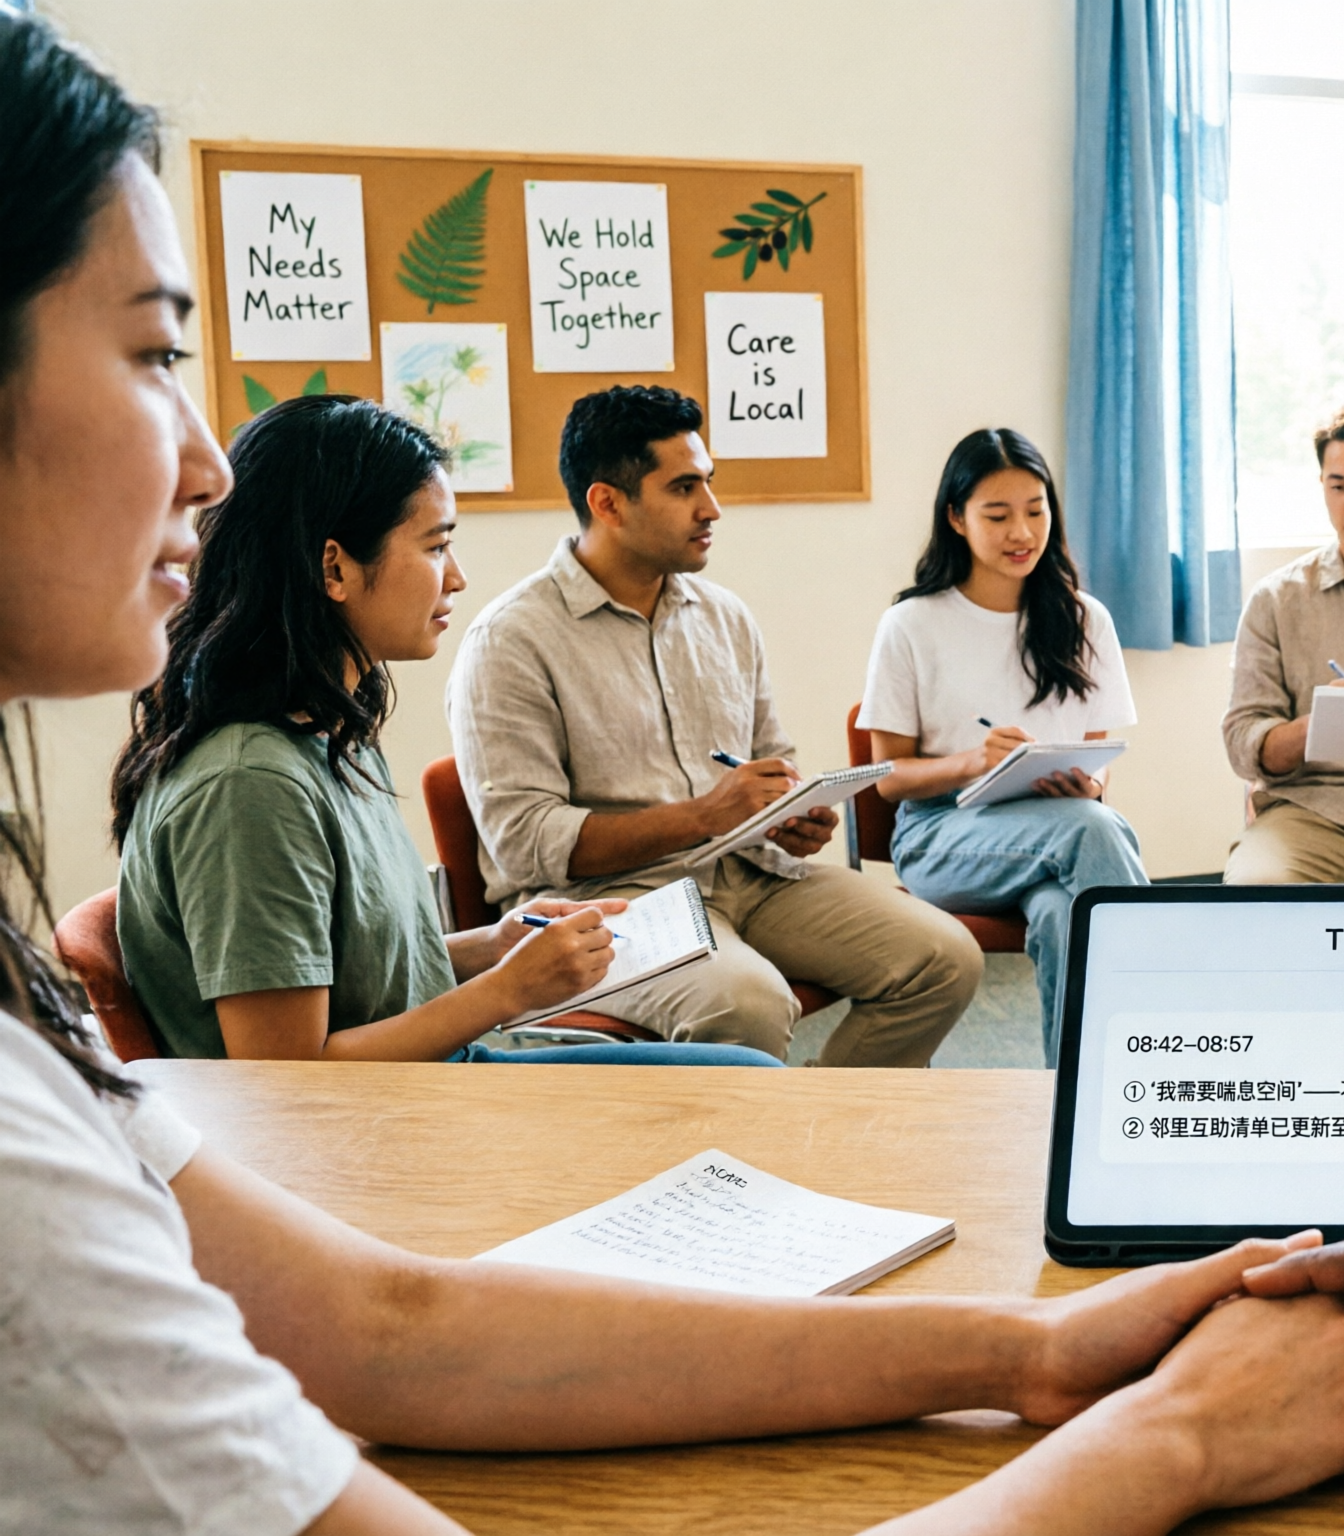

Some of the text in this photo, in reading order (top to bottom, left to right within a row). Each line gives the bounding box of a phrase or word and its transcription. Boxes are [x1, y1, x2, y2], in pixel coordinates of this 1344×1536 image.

[267, 202, 317, 248] My
[538, 217, 655, 249] We Hold
[248, 245, 343, 280] Needs
[557, 257, 641, 302] Space
[242, 289, 353, 323] Matter
[539, 299, 663, 349] Together
[726, 322, 797, 356] Care
[752, 361, 776, 387] is
[727, 387, 805, 422] Local
